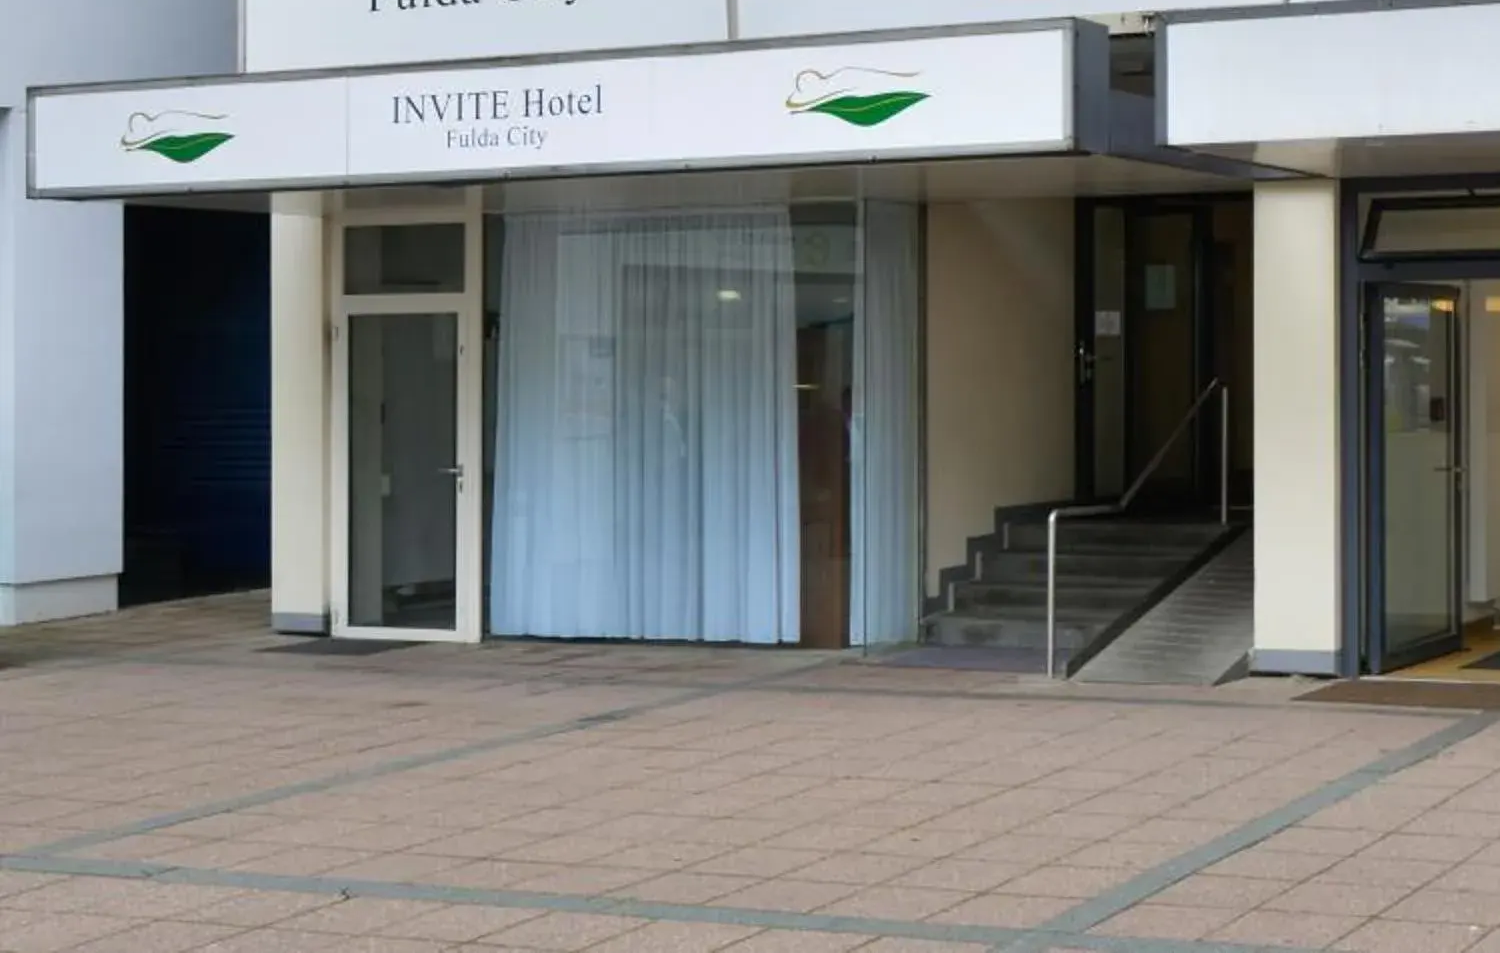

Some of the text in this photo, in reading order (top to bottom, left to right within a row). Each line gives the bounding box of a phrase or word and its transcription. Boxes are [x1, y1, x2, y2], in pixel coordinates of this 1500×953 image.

[393, 84, 604, 124] INVITE Hotel
[446, 126, 547, 150] Fulda City
